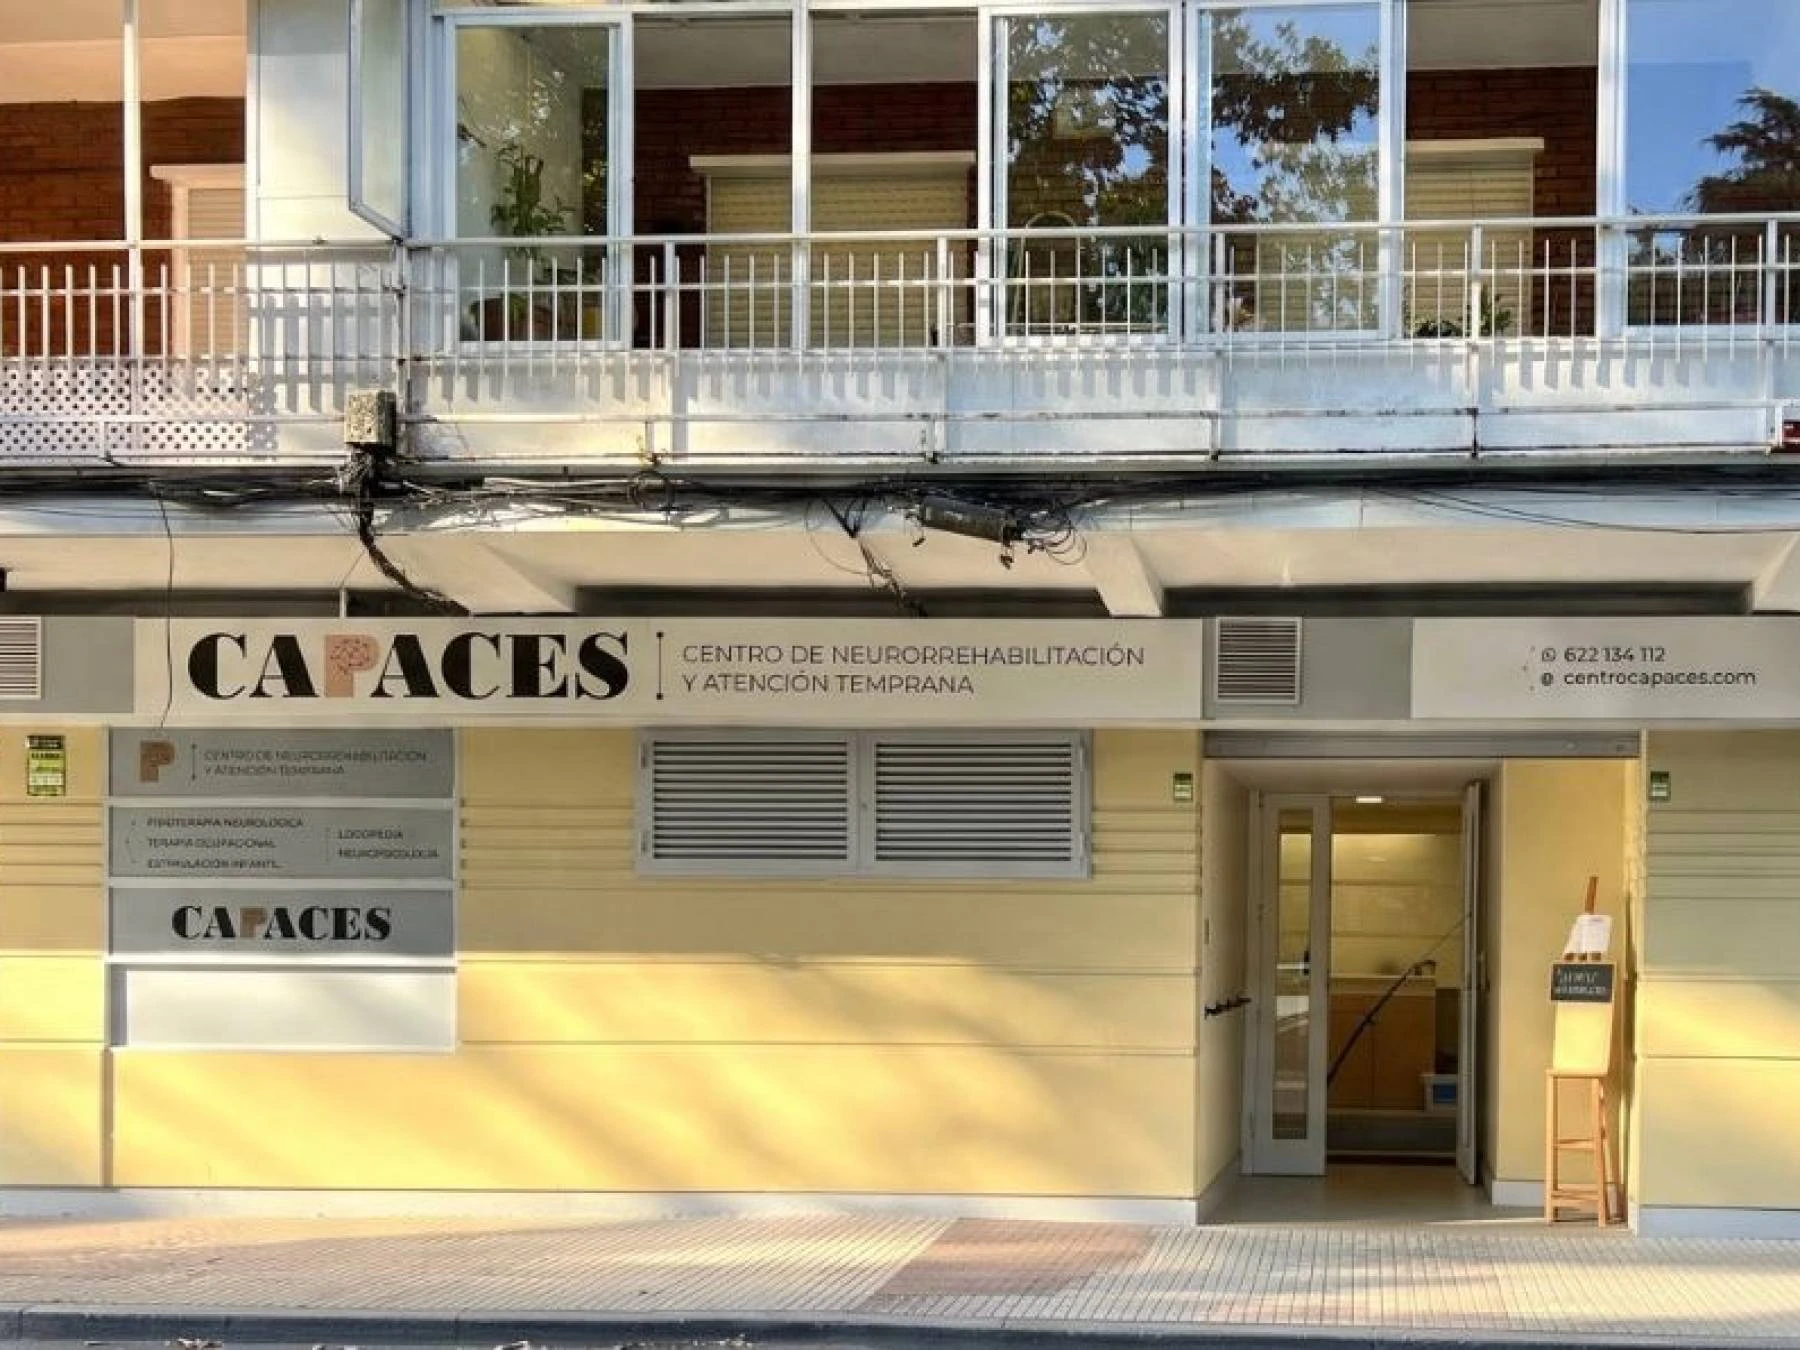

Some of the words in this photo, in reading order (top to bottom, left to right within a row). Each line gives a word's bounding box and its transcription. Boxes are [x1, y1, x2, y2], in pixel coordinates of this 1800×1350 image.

[187, 632, 630, 699] CAPACES
[683, 645, 783, 663] CENTRO
[792, 645, 824, 664] DE
[832, 641, 1144, 666] NEURORREHABILITACIÓN
[1564, 648, 1599, 662] 622
[1603, 648, 1635, 662] 134
[1641, 648, 1666, 662] 112
[682, 673, 698, 692] Y
[703, 670, 829, 693] ATENCIÓN
[834, 674, 974, 694] TEMPRANA
[1564, 671, 1757, 688] centrocapaces.com
[172, 905, 391, 940] CAPACES
